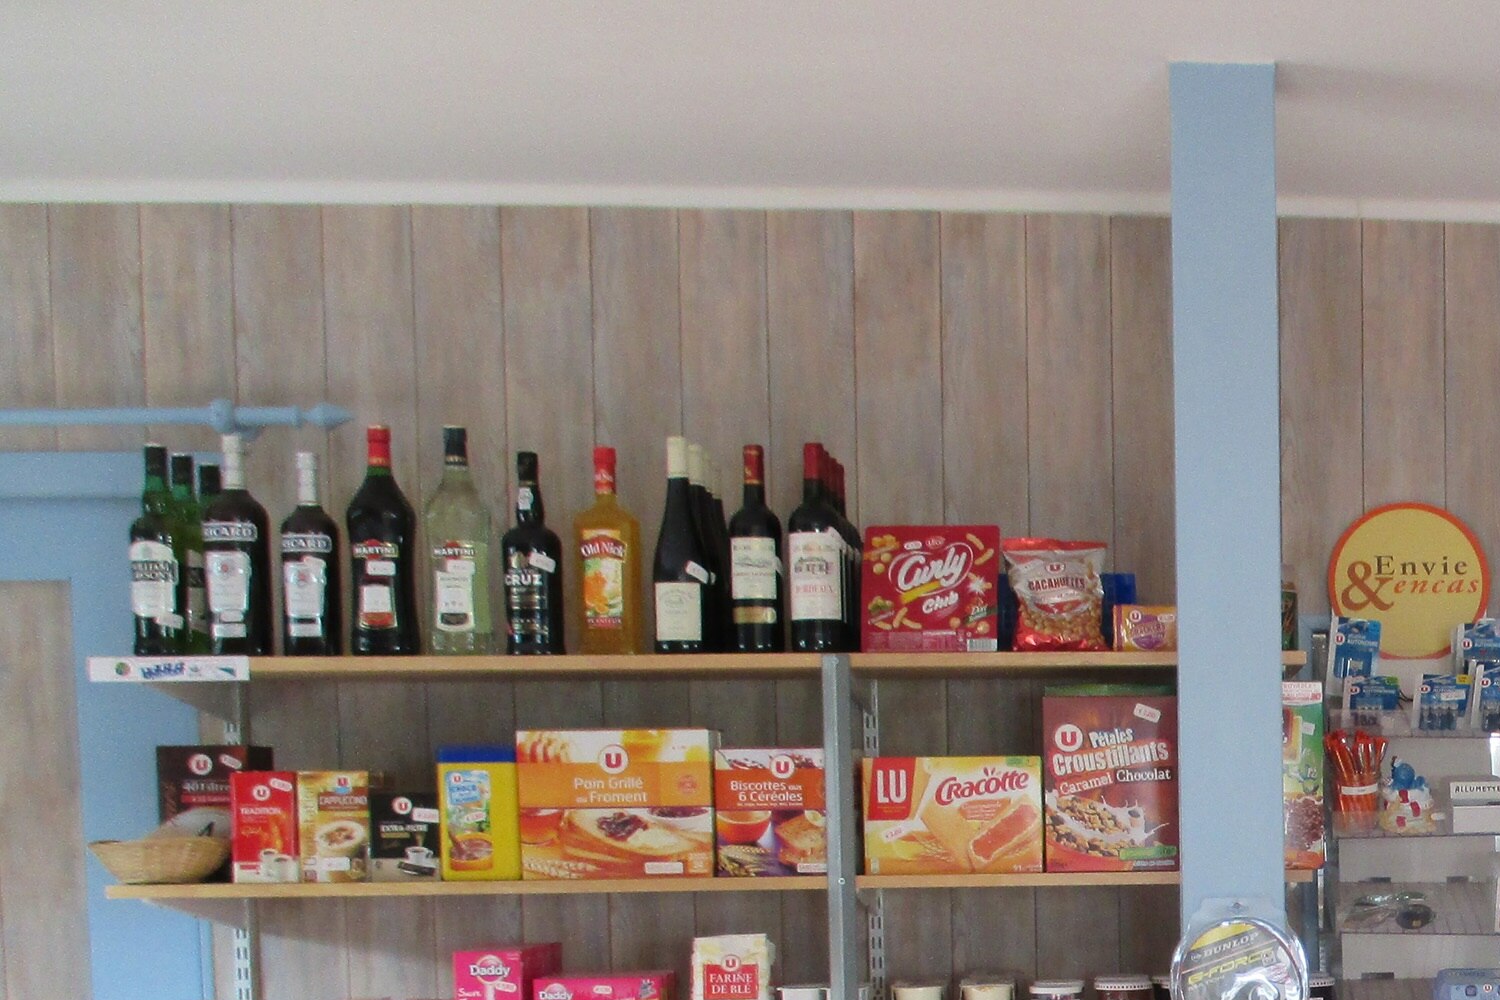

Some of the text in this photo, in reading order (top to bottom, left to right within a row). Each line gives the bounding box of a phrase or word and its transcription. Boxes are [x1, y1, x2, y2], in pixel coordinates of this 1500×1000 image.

[354, 546, 397, 557] MARTINI
[434, 547, 476, 557] MARTINI
[580, 543, 626, 558] Old Nick
[898, 548, 967, 590] Curly
[1374, 555, 1468, 576] Envie
[505, 572, 543, 586] CRUZ
[1341, 560, 1480, 612] & encas
[922, 591, 959, 613] Club
[1060, 730, 1076, 745] U
[1089, 726, 1134, 748] Pétales
[605, 753, 622, 769] U
[1052, 741, 1170, 776] Croustillants
[776, 760, 790, 774] U
[574, 777, 644, 790] Pain Grillé
[730, 781, 786, 791] Biscottes
[877, 769, 907, 804] LU
[935, 767, 1029, 806] Cracotte
[1059, 768, 1172, 795] Caramel Chocolat
[738, 790, 803, 802] 6 Céréales
[1455, 785, 1500, 793] ALLUMETTE
[589, 791, 648, 803] Froment
[240, 806, 282, 816] TRADITION
[1202, 931, 1259, 957] DUNLOP
[469, 965, 511, 978] Daddy
[709, 972, 753, 984] FARINE
[458, 988, 482, 998] Sucre
[711, 984, 726, 994] DE
